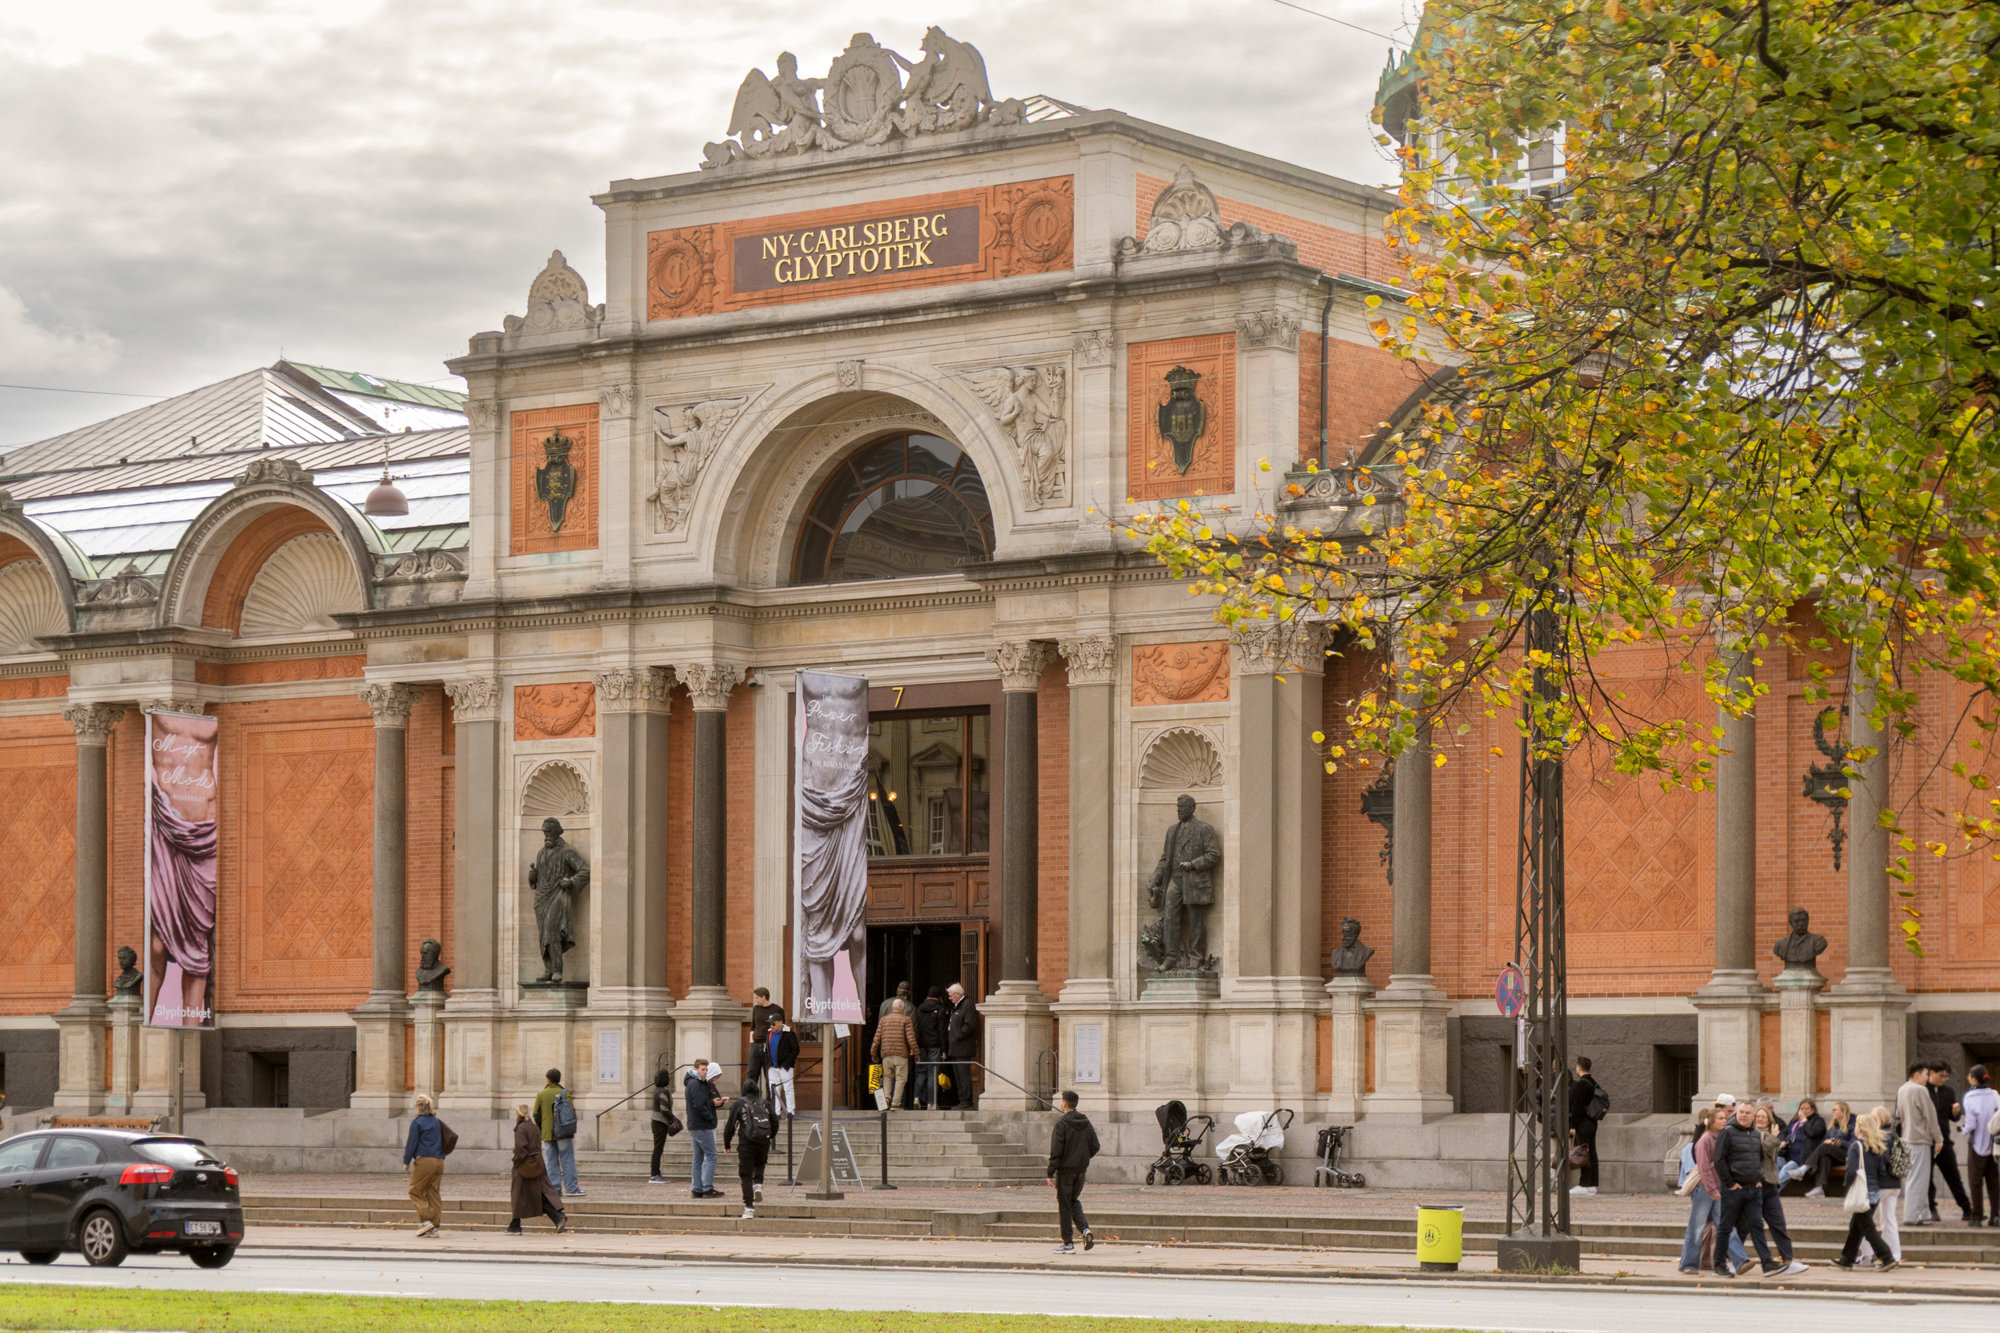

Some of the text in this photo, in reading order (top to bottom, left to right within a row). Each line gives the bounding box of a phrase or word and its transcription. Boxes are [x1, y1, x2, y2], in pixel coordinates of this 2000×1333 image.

[762, 213, 948, 260] NY-CARLSBERG
[774, 240, 933, 284] GLYPTOTEK
[892, 687, 904, 708] 7
[806, 699, 857, 722] Power
[806, 732, 865, 755] Fashion
[155, 1005, 211, 1020] Glyptoteket
[805, 996, 861, 1014] Glyptoteket
